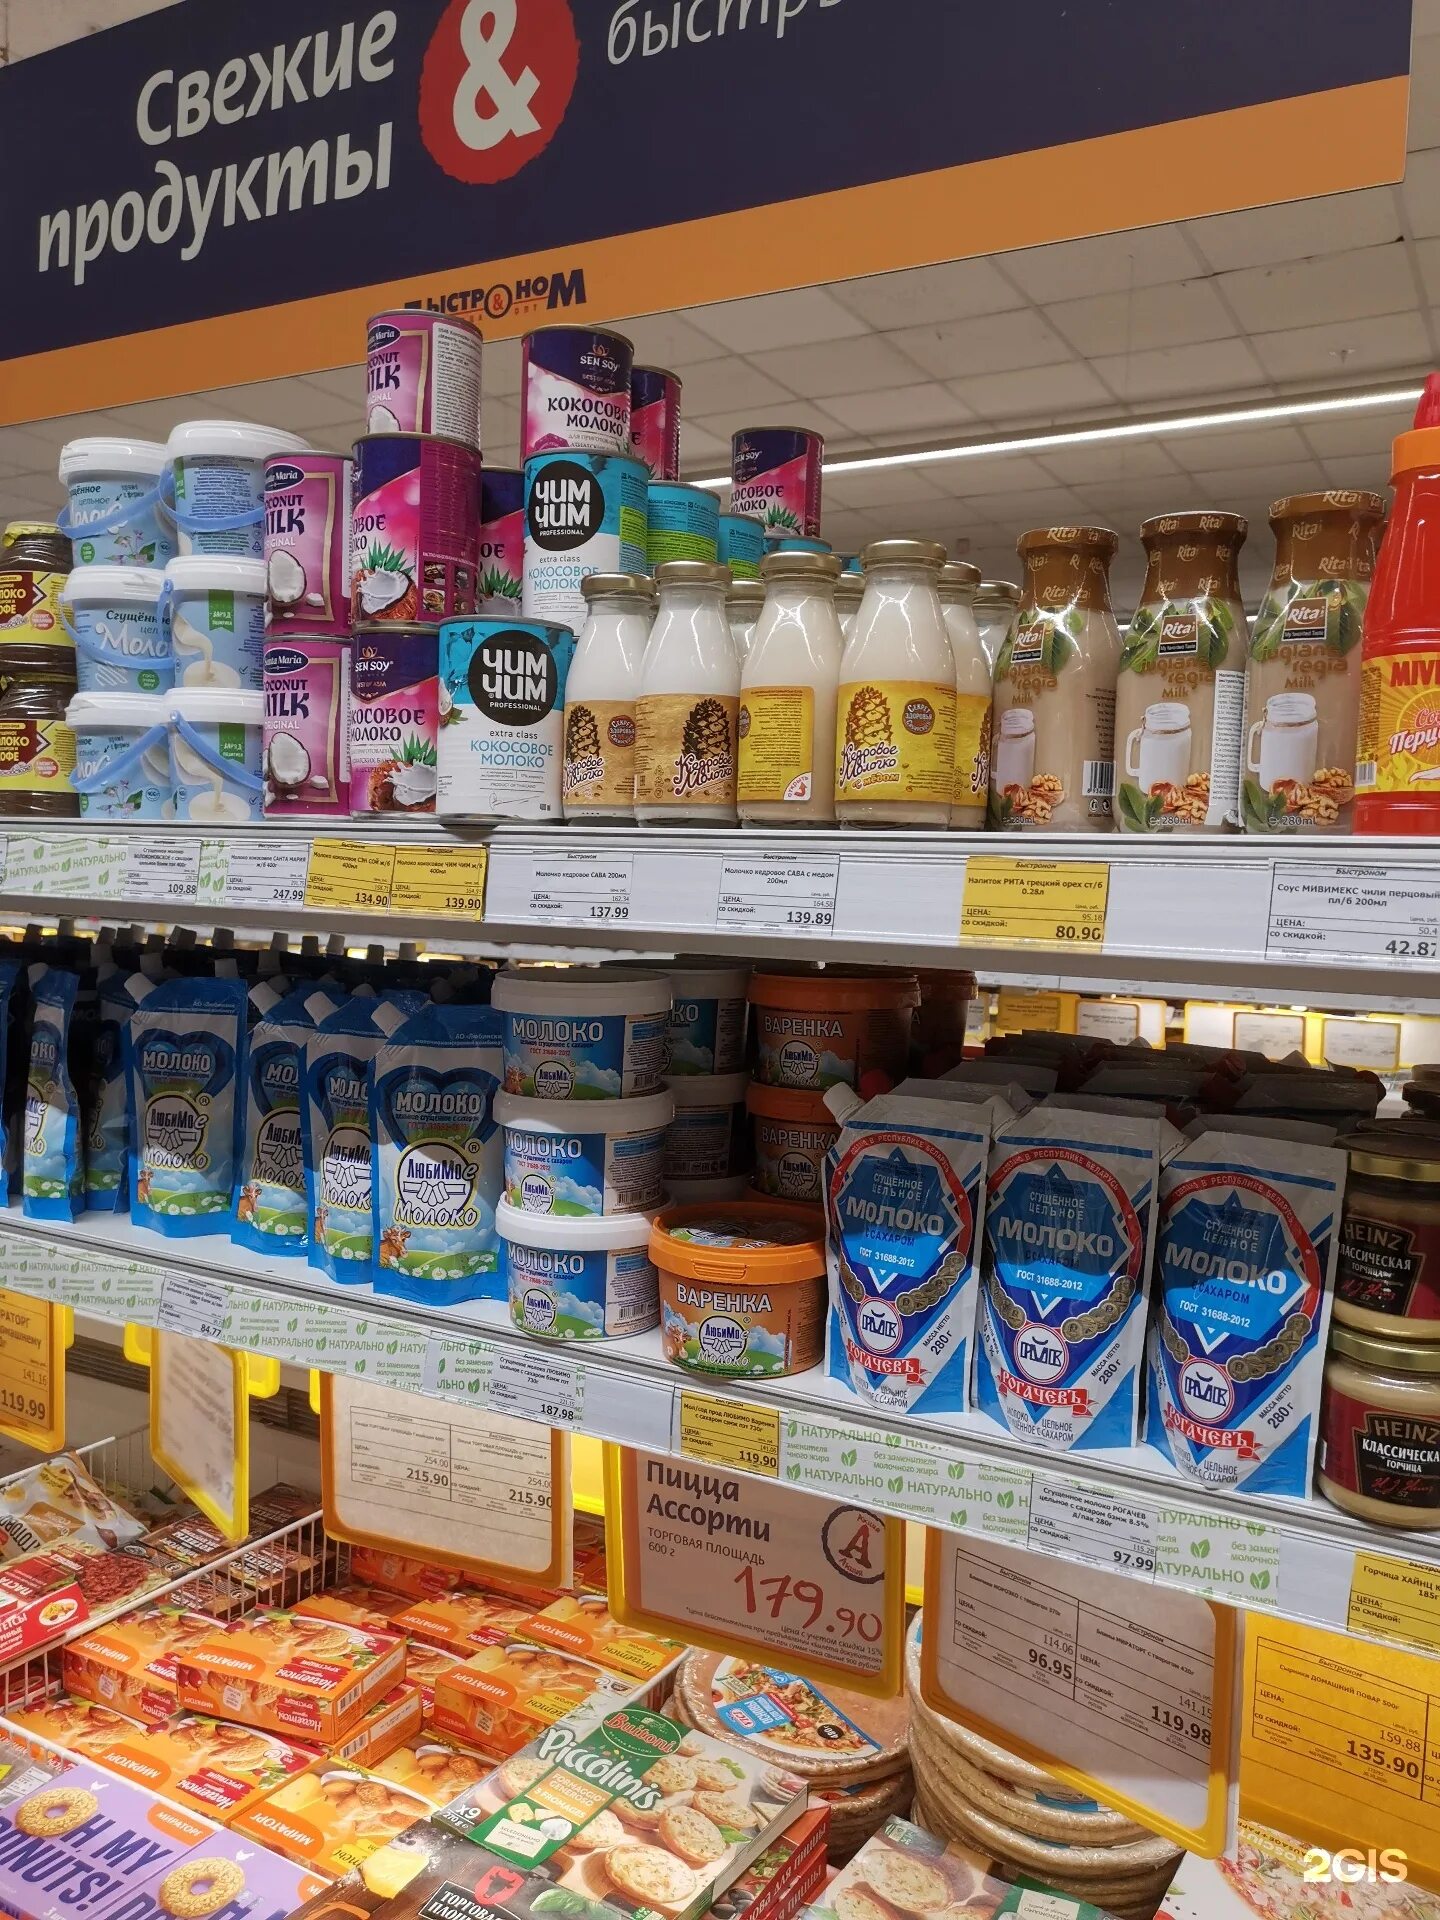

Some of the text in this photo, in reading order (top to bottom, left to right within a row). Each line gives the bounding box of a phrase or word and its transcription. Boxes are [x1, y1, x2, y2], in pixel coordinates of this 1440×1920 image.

[607, 0, 843, 65] быстр
[137, 8, 398, 146] Свежие
[452, 0, 542, 151] &
[37, 122, 393, 286] продукты
[580, 356, 618, 372] SEN SOY
[566, 414, 624, 437] МОЛОКО
[276, 471, 298, 480] Maria
[1323, 490, 1357, 508] Rita
[1158, 518, 1177, 535] Rita
[1199, 516, 1221, 532] Rita
[1292, 520, 1317, 541] Rita
[540, 555, 580, 563] extra class
[1177, 545, 1197, 562] Rita
[1287, 606, 1321, 625] Rita
[1016, 630, 1039, 648] Rita
[1162, 622, 1191, 639] Rita
[278, 654, 302, 664] Maria
[355, 661, 390, 672] SEN SOY
[1292, 657, 1348, 680] regia
[1162, 686, 1189, 699] Milk
[1285, 676, 1315, 689] Milk
[490, 702, 542, 712] PROFESSIONAL
[490, 730, 538, 740] extra class
[470, 740, 554, 756] КОКОСОВОЕ
[480, 754, 544, 768] МОЛОКО
[1281, 815, 1317, 826] 280ml
[73, 852, 127, 868] НАТУРАЛЬНО
[563, 871, 589, 879] кедровое
[591, 871, 607, 879] САВА
[724, 867, 750, 876] Молочко
[752, 869, 785, 877] кедровое
[767, 877, 788, 885] 200мл
[168, 883, 197, 894] 109.88
[1027, 880, 1060, 888] грецкий
[1277, 884, 1386, 897] Соус МИВИМЕКС чили
[273, 889, 303, 900] 247.99
[354, 893, 388, 906] 134.90
[444, 897, 481, 909] 139.90
[1328, 897, 1387, 907] пл/б 200мл
[589, 906, 629, 919] 137.99
[786, 911, 832, 926] 139.89
[1276, 918, 1305, 927] ЦЕНА:
[1056, 926, 1101, 940] 80.90
[512, 1017, 603, 1042] МОЛОКО
[764, 1015, 844, 1037] ВАРЕНКА
[142, 1050, 212, 1072] МОЛОКО
[396, 1090, 481, 1114] МОЛОКО
[505, 1129, 582, 1158] МОЛОКО
[761, 1126, 839, 1150] ВАРЕНКА
[1031, 1150, 1120, 1192] РЕСПУБЛИКЕ БЕЛАРУСЬ
[873, 1173, 923, 1191] СГУЩЕННОЕ
[1030, 1190, 1086, 1209] СГУЩЕННОЕ
[395, 1202, 478, 1226] Молоко
[846, 1196, 945, 1236] МОЛОКО
[1028, 1202, 1084, 1221] ЦЕЛЬНОЕ
[997, 1216, 1115, 1257] МОЛОКО
[1343, 1221, 1403, 1252] HEINZ
[508, 1241, 585, 1274] МОЛОКО
[859, 1246, 915, 1268] ГОСТ 31688-2012
[1165, 1242, 1287, 1294] МОЛОКО
[1016, 1269, 1083, 1291] ГОСТ 31688-2012
[676, 1284, 772, 1313] ВАРЕНКА
[1179, 1299, 1251, 1329] ГОСТ 31688-2012
[200, 1323, 222, 1337] 84.77
[329, 1340, 384, 1352] НАТУРАЛЬНО
[929, 1335, 949, 1356] 280
[697, 1348, 749, 1367] Молоко
[1098, 1364, 1117, 1386] 280
[1001, 1368, 1082, 1406] РОГАЧЕВЪ
[1, 1389, 46, 1420] 119.99
[540, 1403, 574, 1420] 187.98
[1267, 1405, 1290, 1430] 280
[801, 1425, 881, 1444] НАТУРАЛЬНО
[1041, 1426, 1074, 1442] САХАРОМ
[1374, 1417, 1439, 1445] HEINZ
[739, 1450, 777, 1468] 119.90
[1386, 1459, 1423, 1474] ГОРЧИЦА
[406, 1467, 449, 1487] 215.90
[647, 1459, 740, 1505] Пицца
[907, 1481, 993, 1503] НАТУРАЛЬНО
[646, 1493, 771, 1543] Ассорти
[1112, 1505, 1146, 1520] РОГАЧЕВ
[648, 1526, 766, 1566] ТОРГОВАЯ ПЛОЩАДЬ
[1113, 1550, 1154, 1571] 97.99
[1363, 1565, 1433, 1590] Горчица ХАЙНЦ
[734, 1565, 883, 1642] 179.90
[193, 1652, 257, 1674] МИРАТОРГ
[1028, 1647, 1072, 1681] 96.95
[452, 1672, 509, 1698] МИРАТОРГ
[1310, 1675, 1354, 1695] ДОМАШНИЙ
[604, 1712, 677, 1755] Buitoni
[1151, 1704, 1212, 1745] 119.98
[1379, 1729, 1421, 1752] 159.88
[104, 1752, 161, 1779] МИРАТОРГ
[538, 1727, 662, 1811] Piccolinis
[1346, 1740, 1419, 1779] 135.90
[456, 1804, 482, 1820] x9
[157, 1811, 203, 1837] МИРАТОРГ
[249, 1812, 314, 1847] МИРАТОРГ
[100, 1829, 173, 1877] MY
